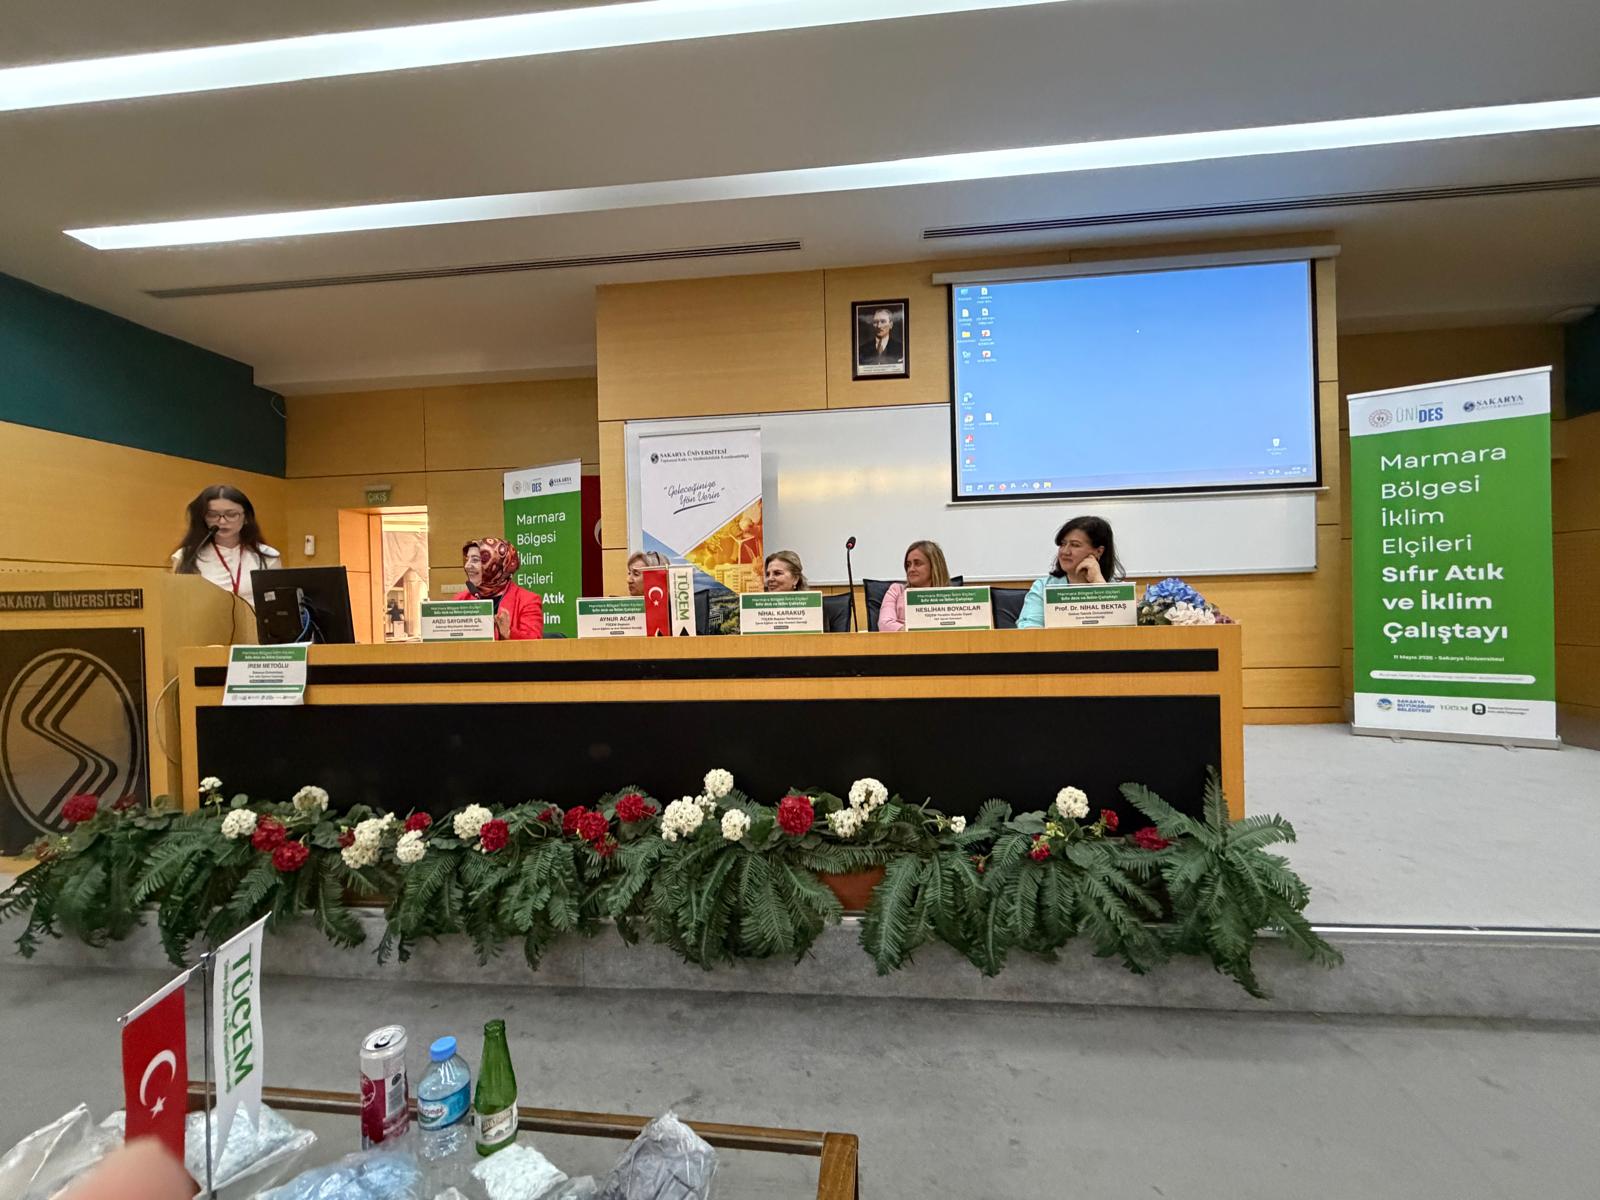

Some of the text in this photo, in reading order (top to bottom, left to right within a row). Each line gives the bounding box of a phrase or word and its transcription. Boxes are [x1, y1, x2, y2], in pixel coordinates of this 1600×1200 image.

[1476, 395, 1523, 407] SAKARYA
[1381, 447, 1507, 471] Marmara
[1381, 475, 1480, 500] Bölgesi
[517, 511, 566, 526] Marmara
[1381, 507, 1444, 527] İklim
[517, 531, 556, 547] Bölgesi
[1383, 534, 1472, 558] Elçileri
[517, 572, 553, 588] Elçileri
[1382, 563, 1505, 583] Sıfır Atık
[0, 591, 136, 609] AKARYA ÜNİVERSİTESİ
[542, 592, 565, 604] Atık
[1382, 589, 1492, 610] ve İklim
[1383, 622, 1508, 644] Çalıştayı
[229, 943, 254, 1086] TÜÇEM
